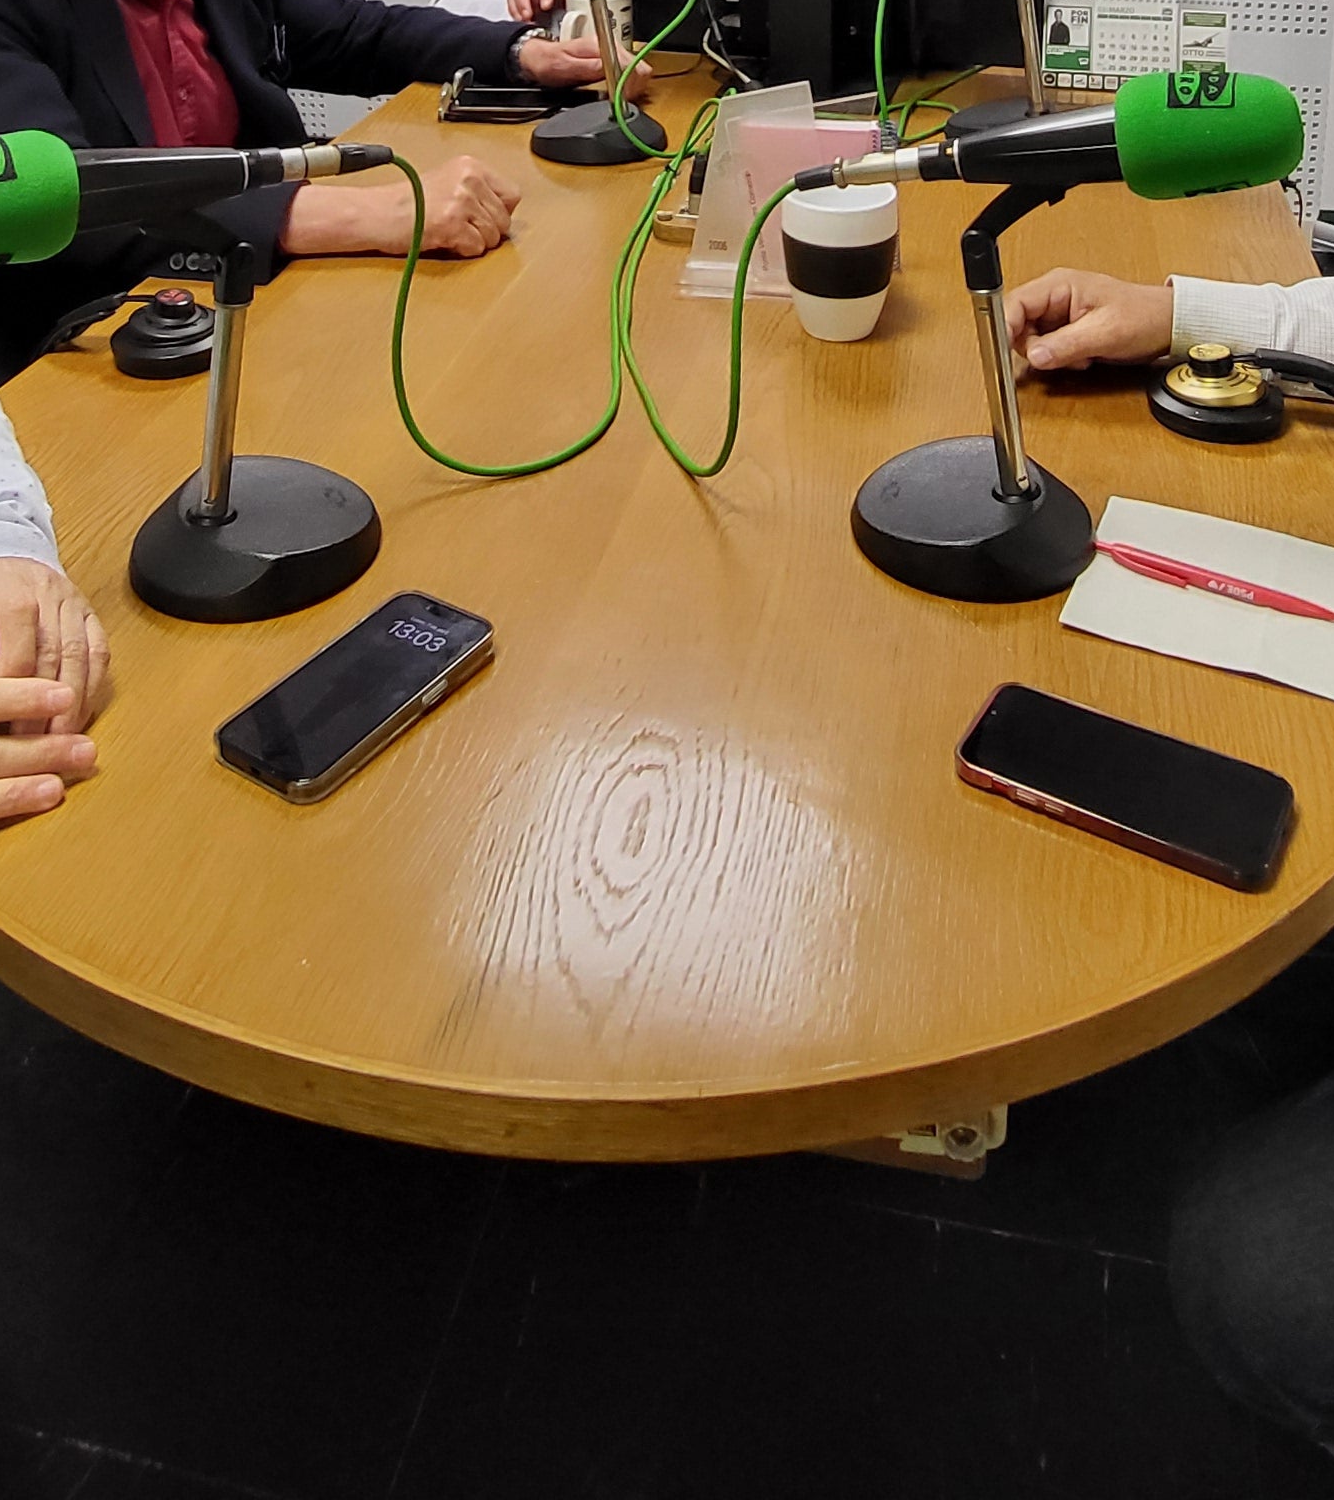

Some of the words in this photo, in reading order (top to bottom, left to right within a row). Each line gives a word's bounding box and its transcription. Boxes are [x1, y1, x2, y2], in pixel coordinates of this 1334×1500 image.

[1071, 16, 1088, 24] FIN
[1182, 49, 1204, 57] OTTO
[388, 620, 447, 652] 13:03
